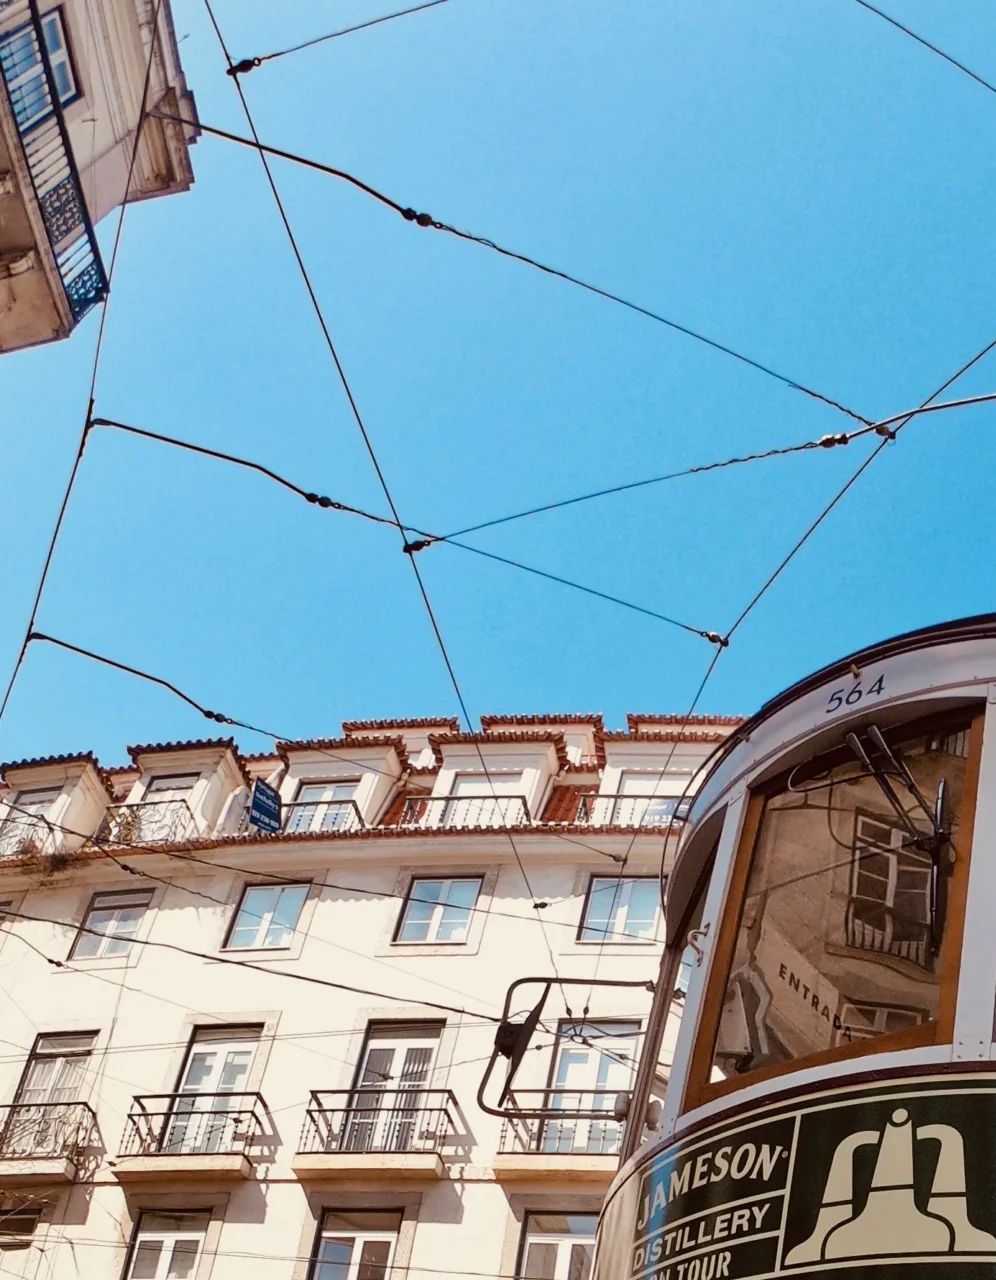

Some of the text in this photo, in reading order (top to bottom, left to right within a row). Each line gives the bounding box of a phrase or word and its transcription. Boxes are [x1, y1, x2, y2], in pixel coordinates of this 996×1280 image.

[825, 673, 885, 714] 564
[778, 962, 852, 1043] ENTRADA
[632, 1203, 771, 1272] DISTILLERY
